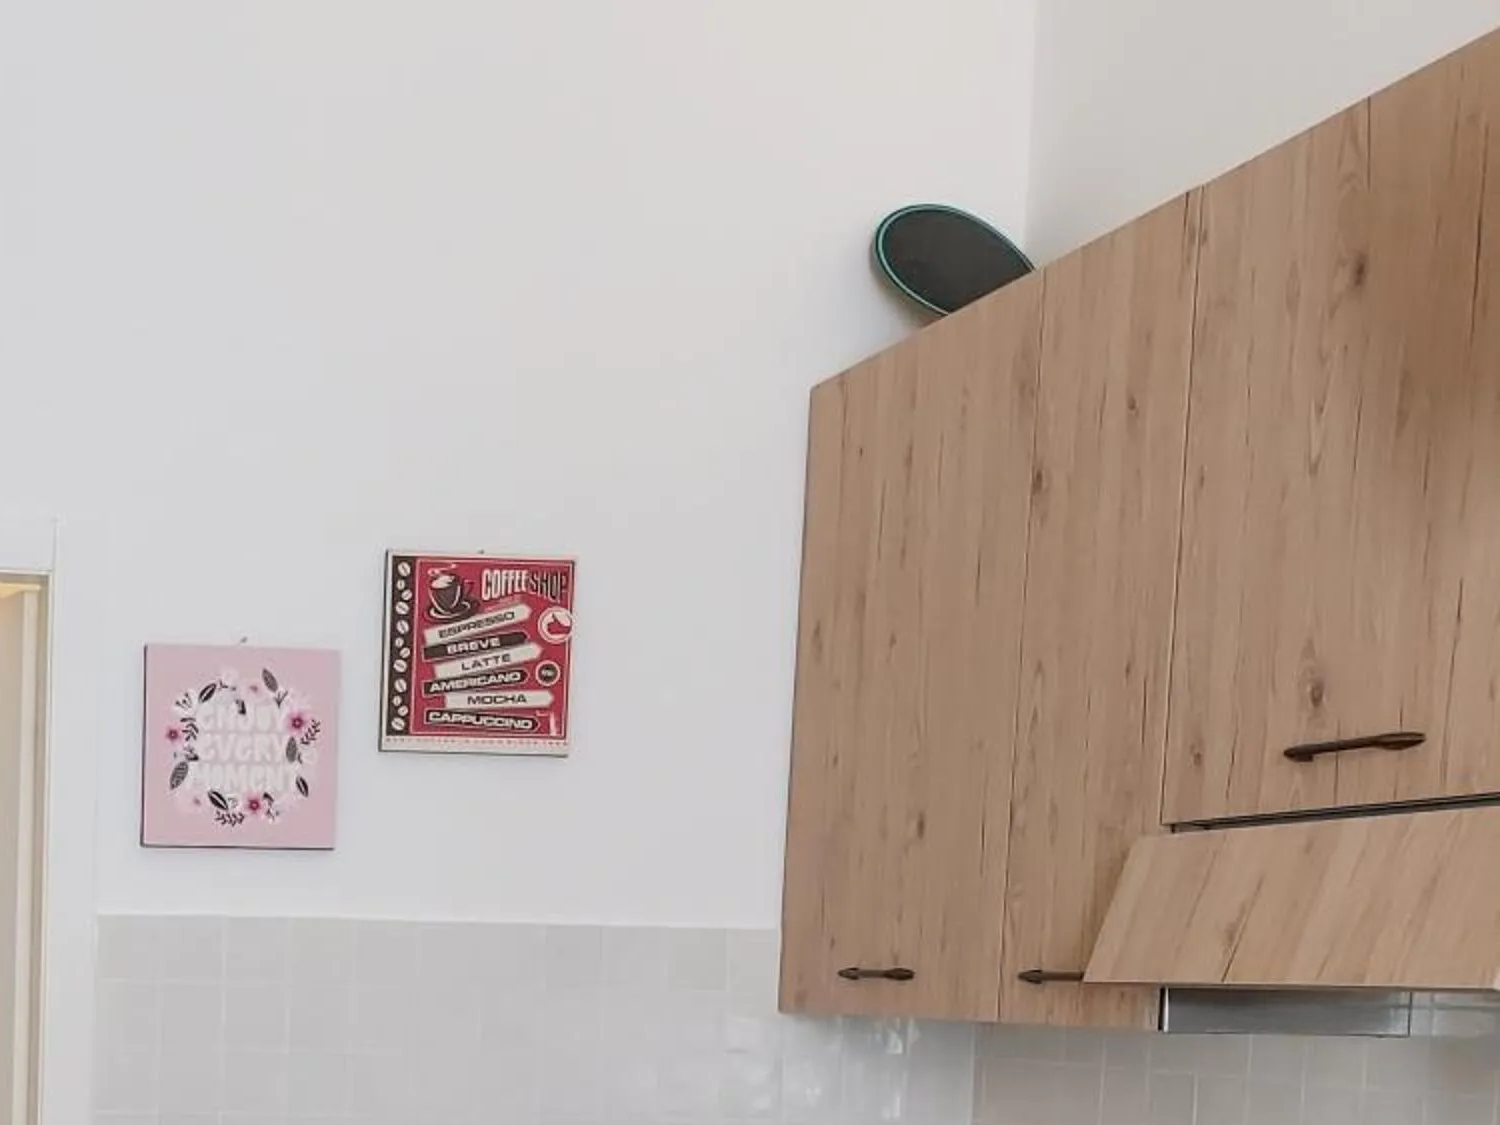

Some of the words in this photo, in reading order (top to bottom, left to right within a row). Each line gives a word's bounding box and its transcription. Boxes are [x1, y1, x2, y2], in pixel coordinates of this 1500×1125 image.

[481, 568, 529, 600] COFFEE
[529, 570, 569, 602] SHOP
[438, 611, 515, 638] ESPRESSO
[447, 637, 500, 654] BREVE
[461, 653, 511, 670] LATTE
[429, 671, 521, 693] AMERICANO
[467, 693, 527, 705] MOCHA
[428, 711, 533, 729] CAPPUCCINO
